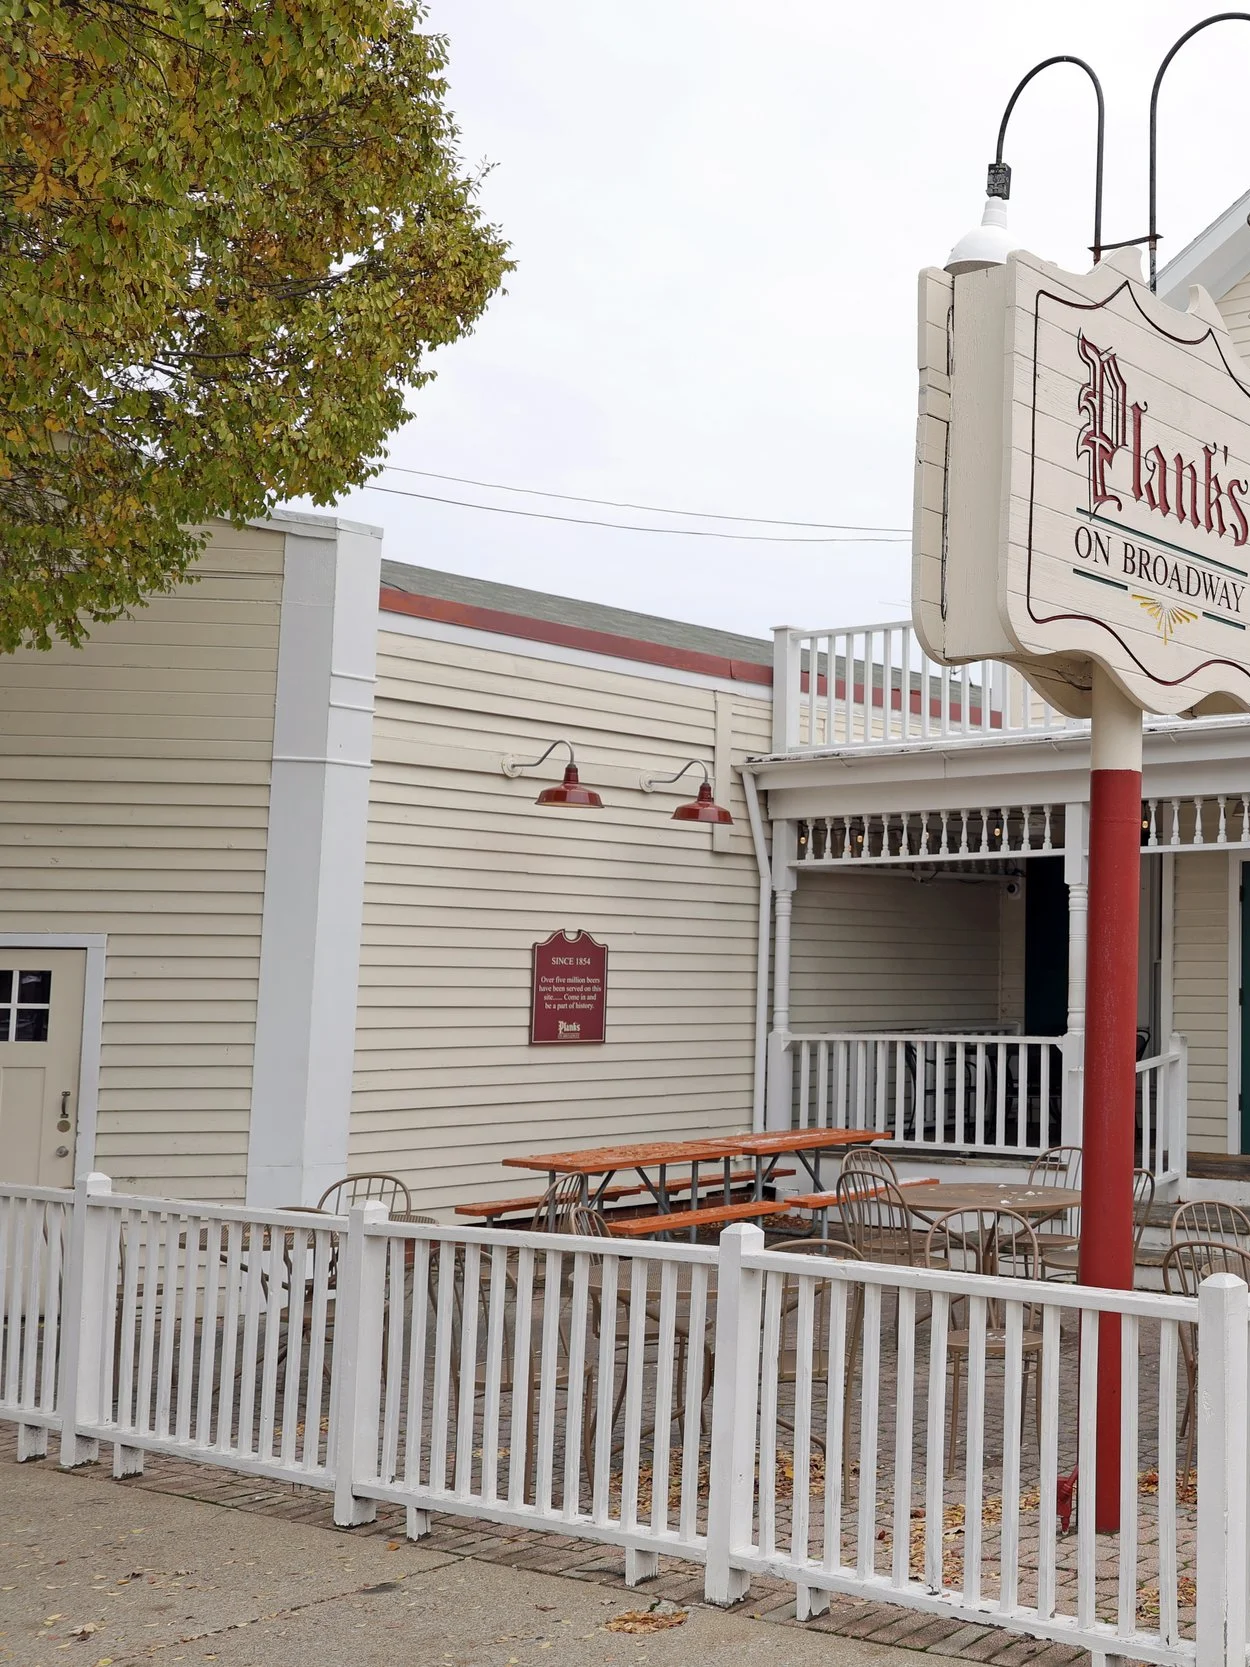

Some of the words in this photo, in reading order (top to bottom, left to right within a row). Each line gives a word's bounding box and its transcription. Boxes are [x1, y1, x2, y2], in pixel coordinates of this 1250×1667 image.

[1076, 327, 1248, 547] Plank's
[1074, 526, 1112, 567] ON
[1122, 541, 1246, 613] BROADWAY
[551, 957, 574, 966] SINCE
[576, 957, 591, 966] 1854
[586, 976, 601, 984] beers
[538, 984, 552, 992] have
[552, 984, 566, 992] been
[563, 993, 580, 1001] Come
[580, 993, 586, 1001] in
[586, 993, 597, 1001] and
[544, 1002, 552, 1010] be
[557, 1003, 568, 1011] part
[569, 1002, 575, 1010] of
